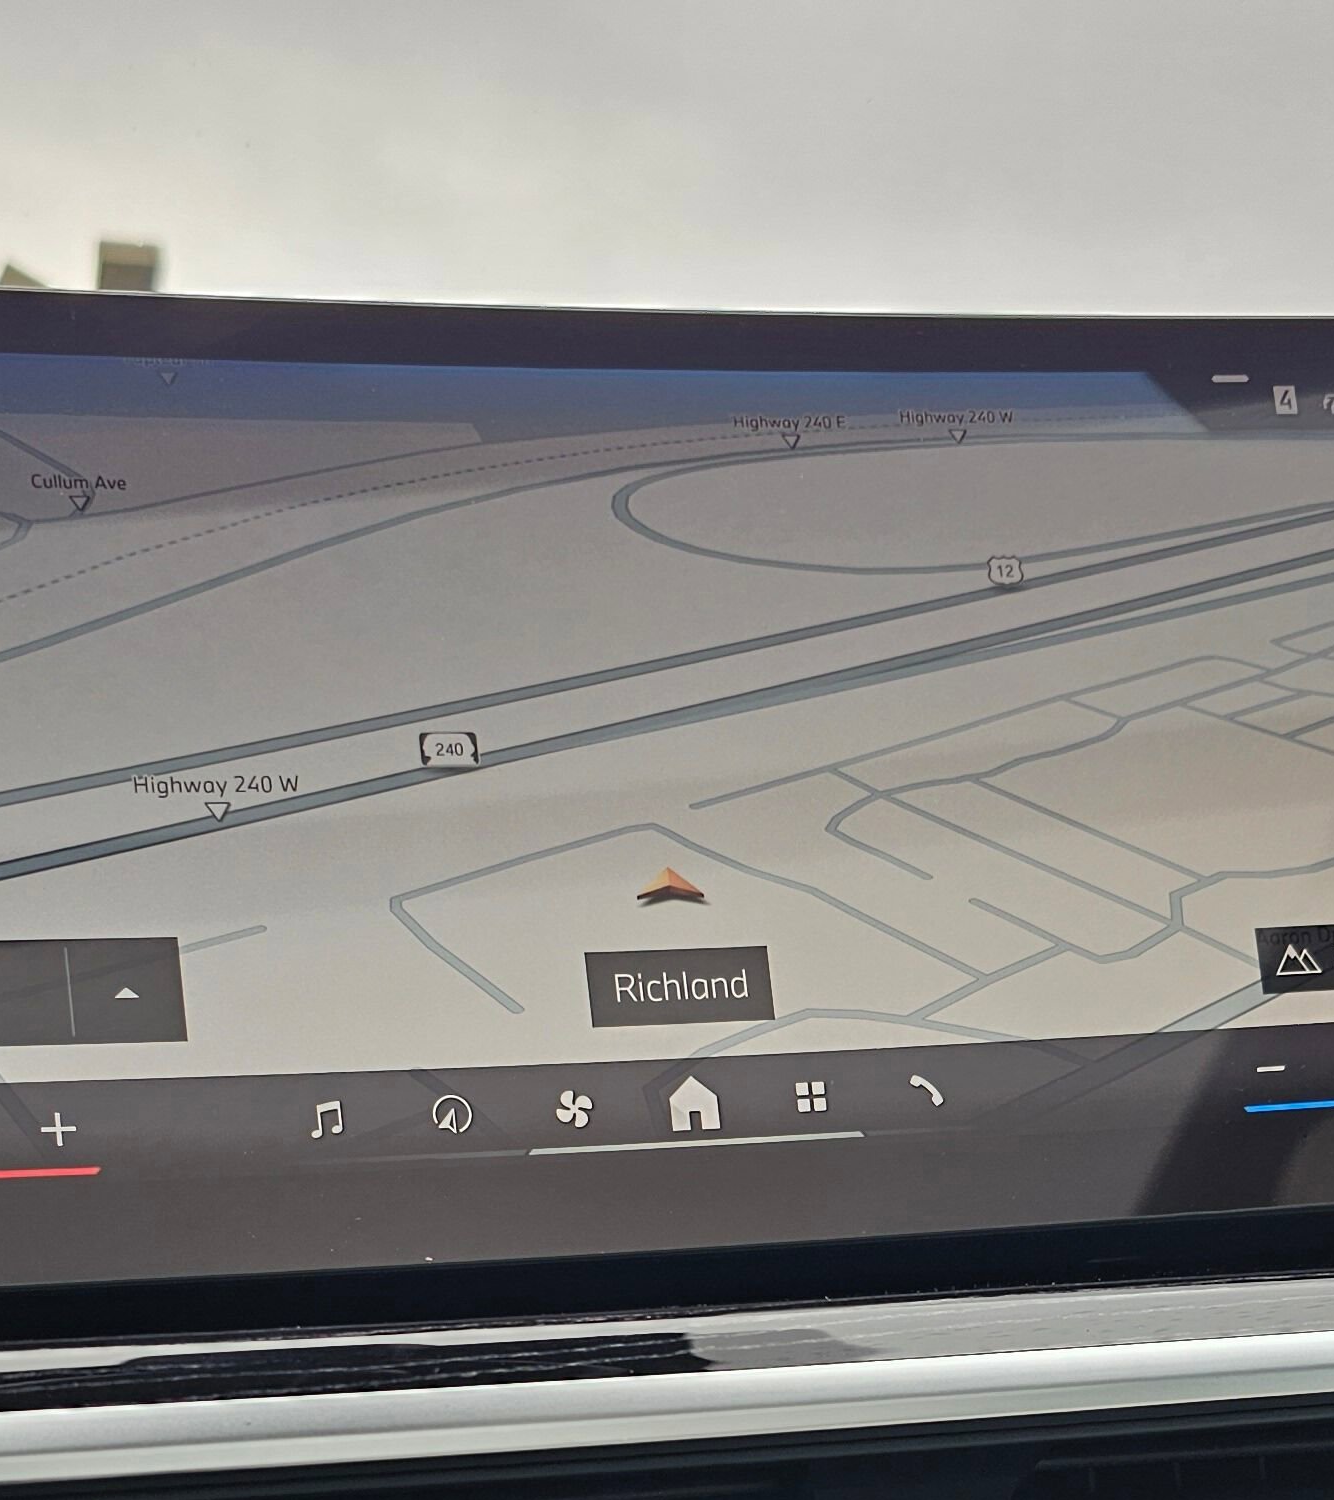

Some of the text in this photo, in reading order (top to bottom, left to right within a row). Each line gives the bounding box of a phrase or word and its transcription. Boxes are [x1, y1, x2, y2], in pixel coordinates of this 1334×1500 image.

[733, 415, 846, 431] Highway 240 E
[899, 410, 1014, 427] Highway 240 W
[31, 473, 127, 490] Cullum Ave
[997, 564, 1013, 578] 12
[435, 741, 464, 758] 240
[132, 774, 299, 796] Highway 240 W
[614, 968, 749, 1003] Richland
